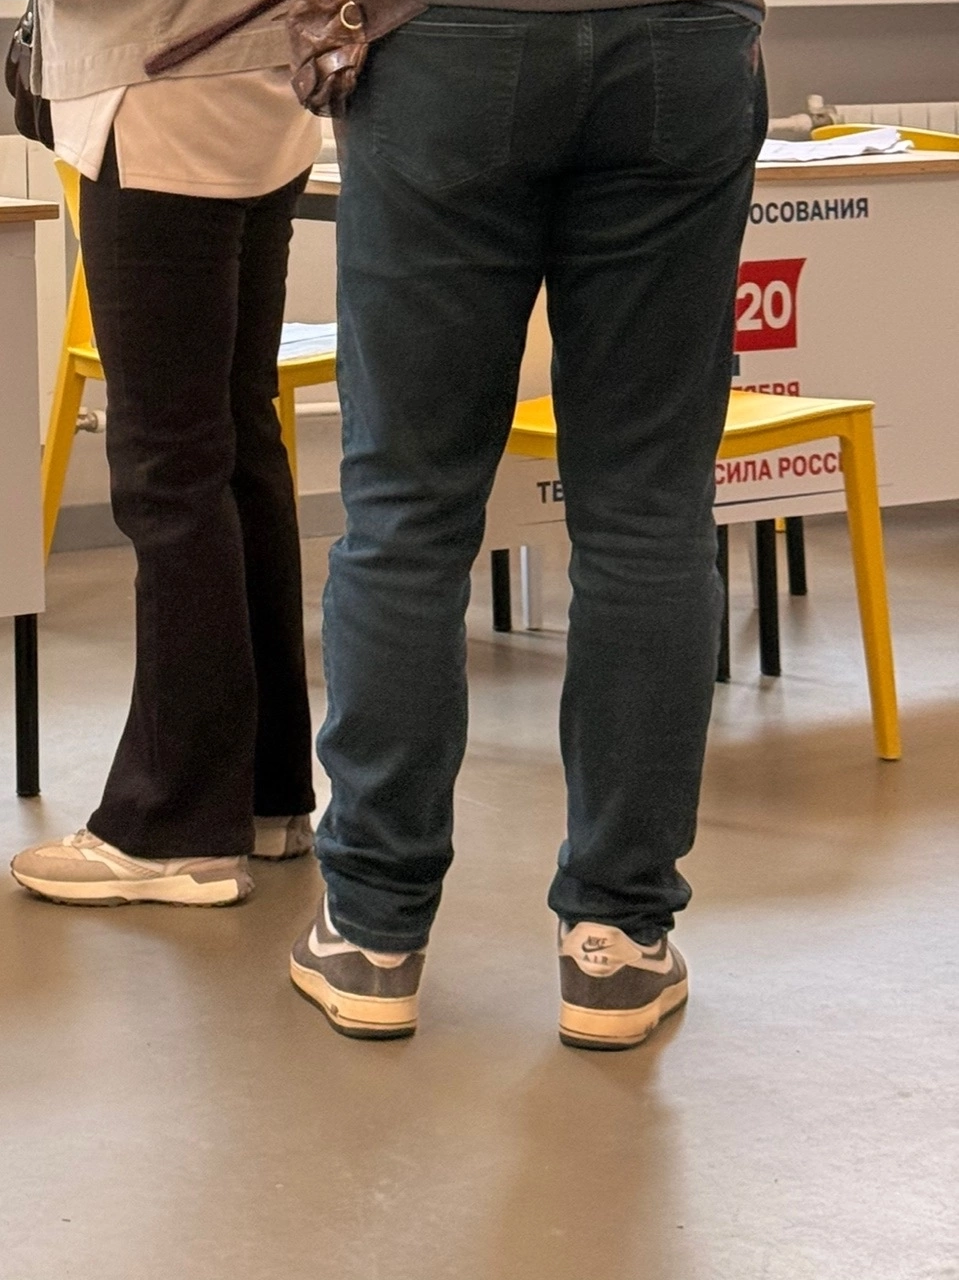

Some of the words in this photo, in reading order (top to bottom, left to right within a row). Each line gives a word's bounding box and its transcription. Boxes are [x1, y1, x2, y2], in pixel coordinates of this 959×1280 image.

[749, 197, 869, 225] ОСОВАНИЯ
[736, 280, 792, 331] 20
[715, 458, 772, 485] СИЛА
[778, 452, 844, 478] РОСС
[536, 480, 564, 504] ТВ
[583, 954, 608, 965] AIR
